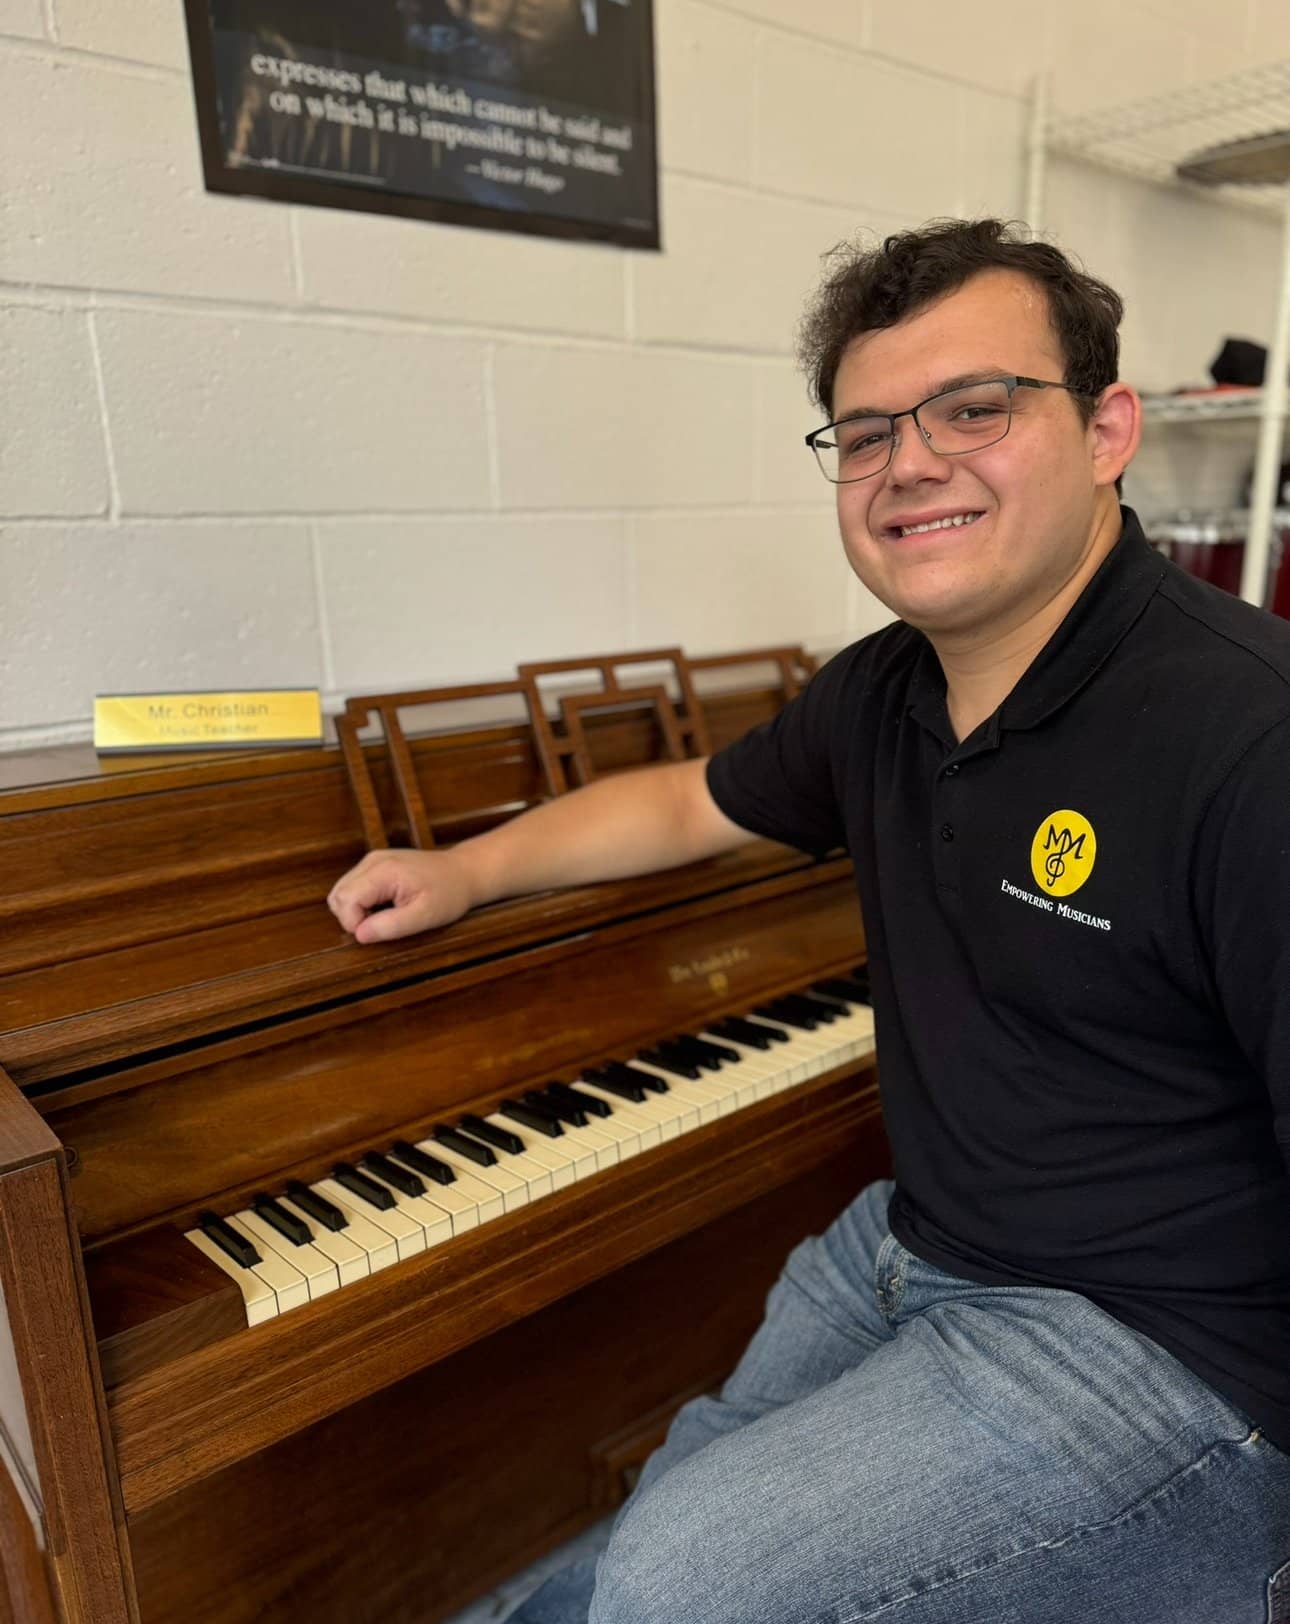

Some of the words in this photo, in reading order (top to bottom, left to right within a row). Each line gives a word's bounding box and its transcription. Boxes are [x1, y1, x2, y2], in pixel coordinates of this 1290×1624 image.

[251, 54, 362, 94] expresses
[365, 70, 407, 103] that
[409, 82, 472, 117] which
[270, 91, 301, 115] on
[305, 93, 375, 128] which
[376, 103, 395, 132] it
[398, 107, 419, 136] is
[182, 702, 269, 720] Christian
